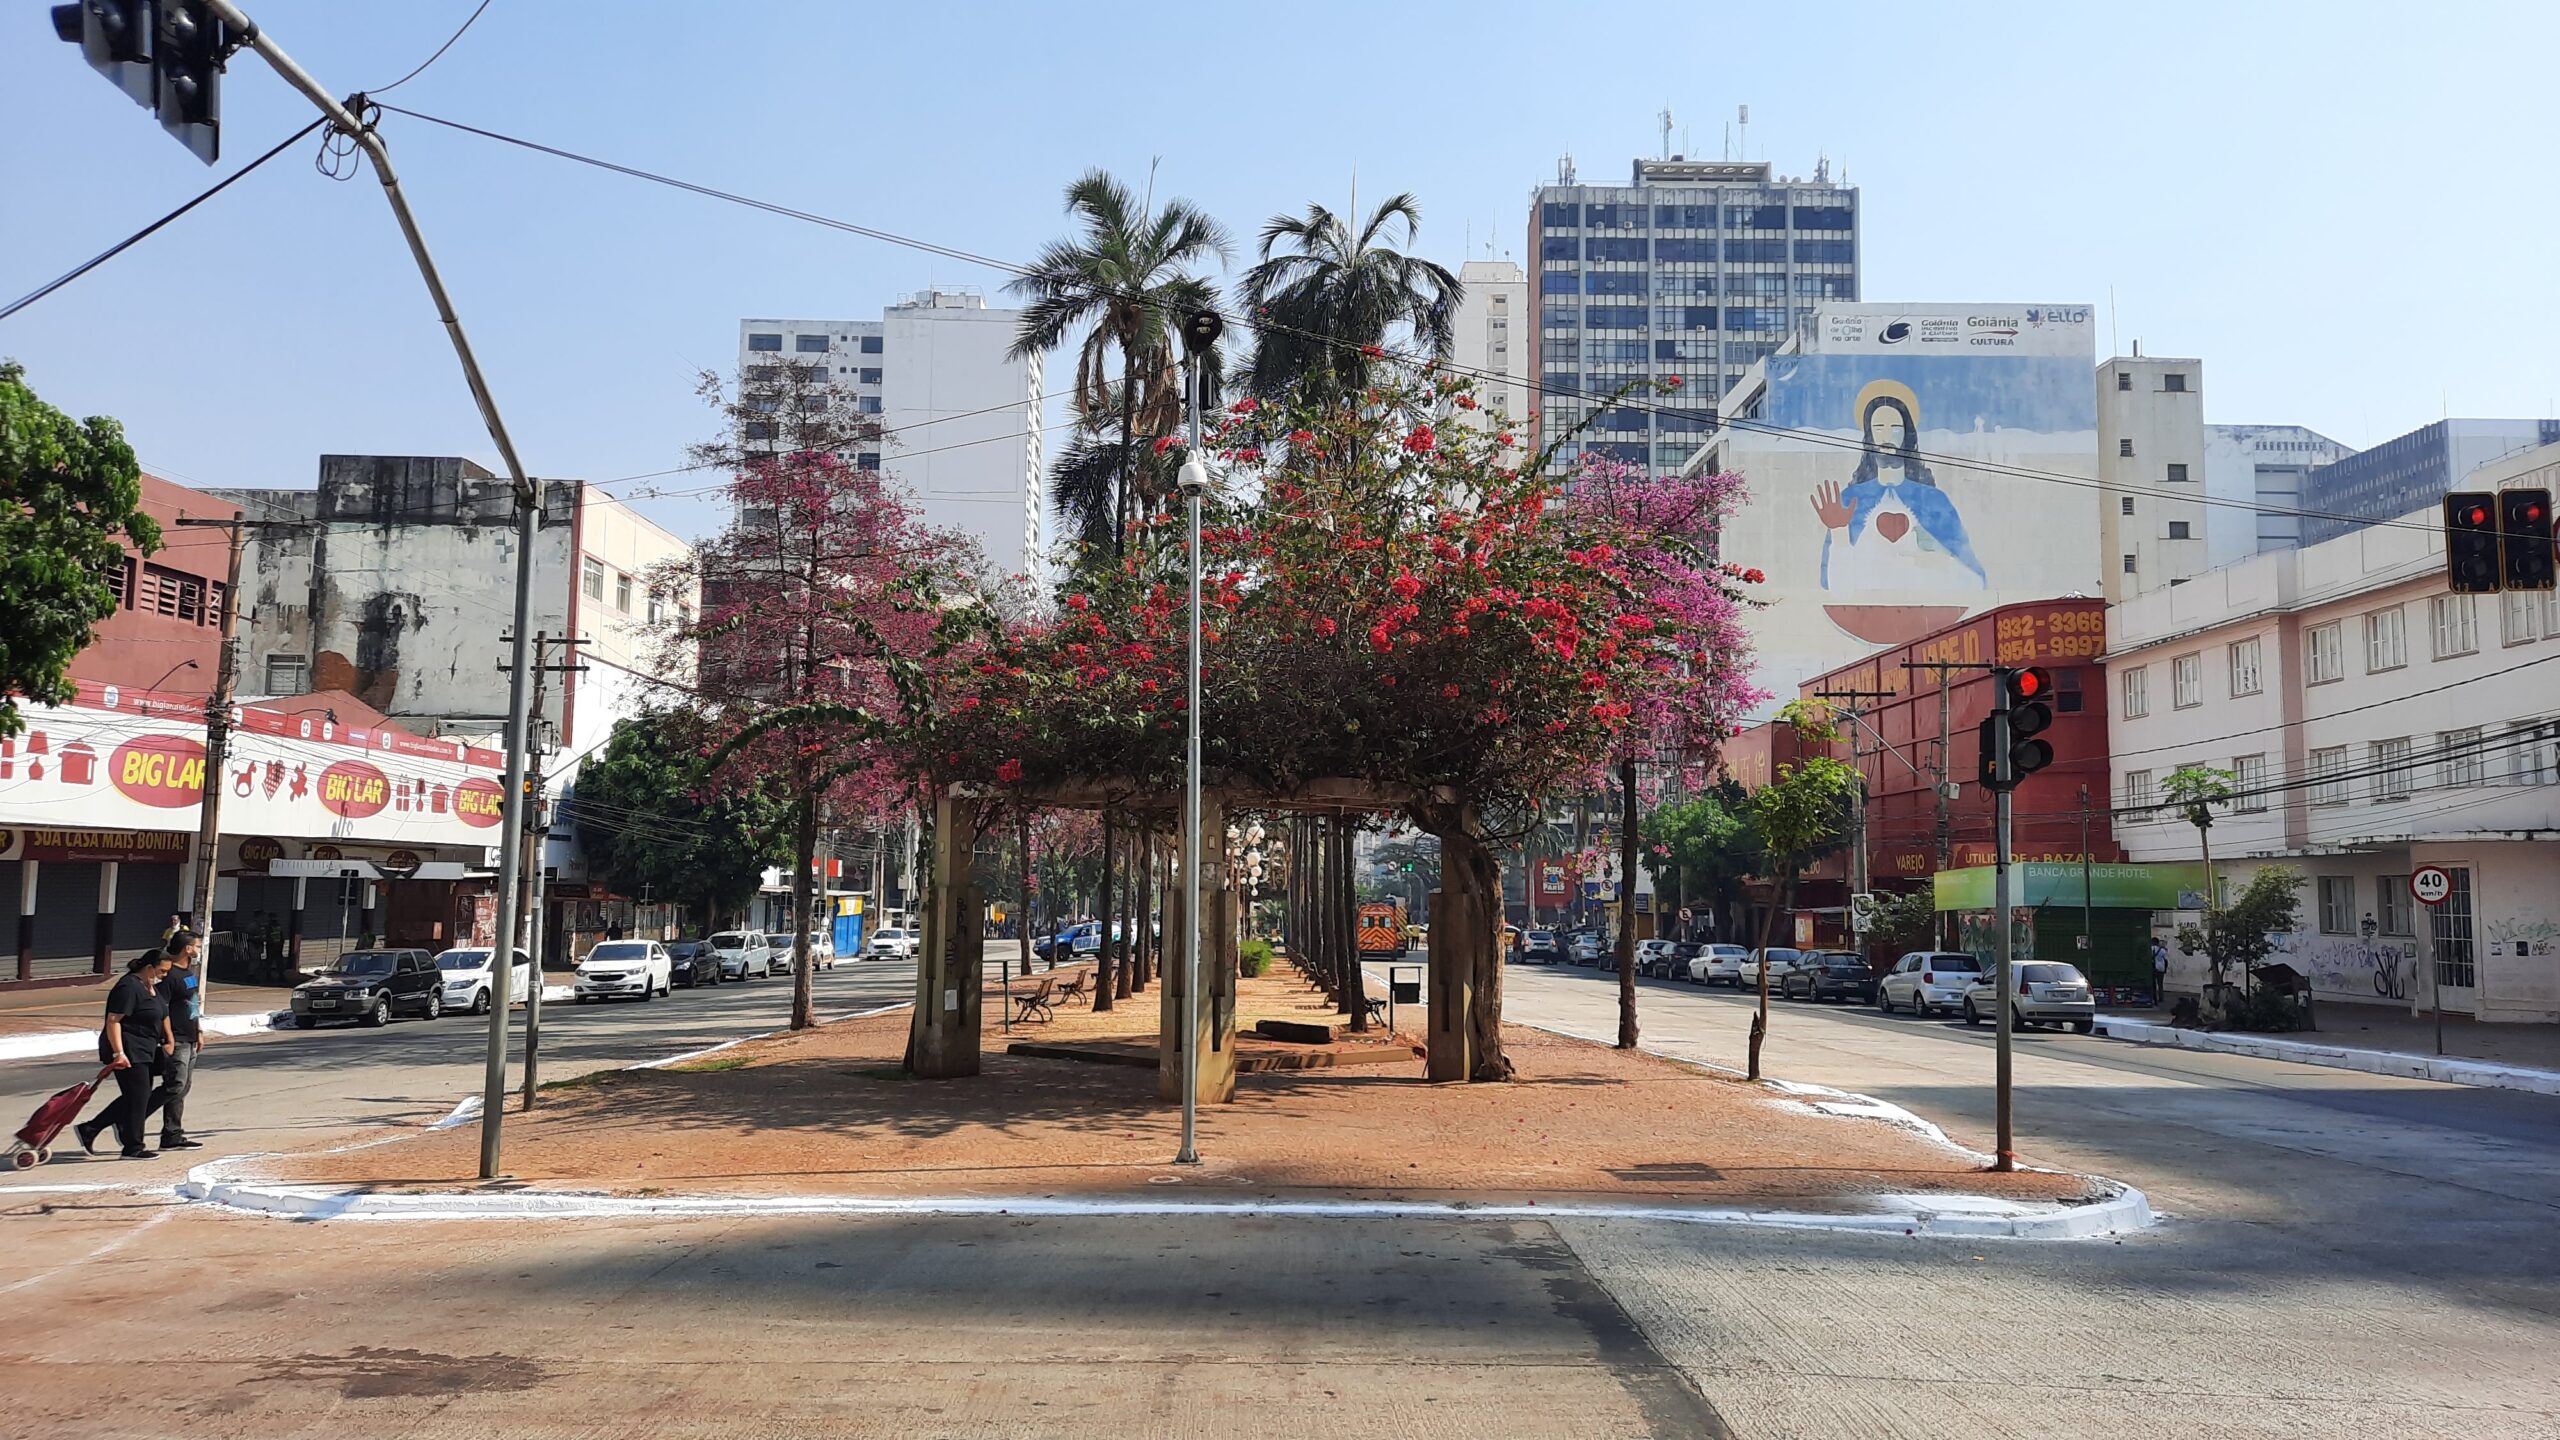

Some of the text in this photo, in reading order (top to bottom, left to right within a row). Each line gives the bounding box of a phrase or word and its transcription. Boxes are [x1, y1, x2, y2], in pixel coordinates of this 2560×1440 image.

[1967, 316, 2019, 327] Goiânia
[1970, 338, 2015, 346] CULTURA
[122, 751, 165, 788] BIG
[325, 773, 384, 805] BIG LAR
[458, 789, 478, 814] BIG
[34, 831, 185, 850] SUA CASA MAIS BONITA!
[244, 845, 279, 860] BIG LAR
[1965, 853, 2027, 865] UTILIDDE
[1896, 853, 1925, 874] VAREJO
[2028, 867, 2067, 878] BANCA
[2117, 868, 2152, 879] HOTEL
[2420, 873, 2442, 888] 40
